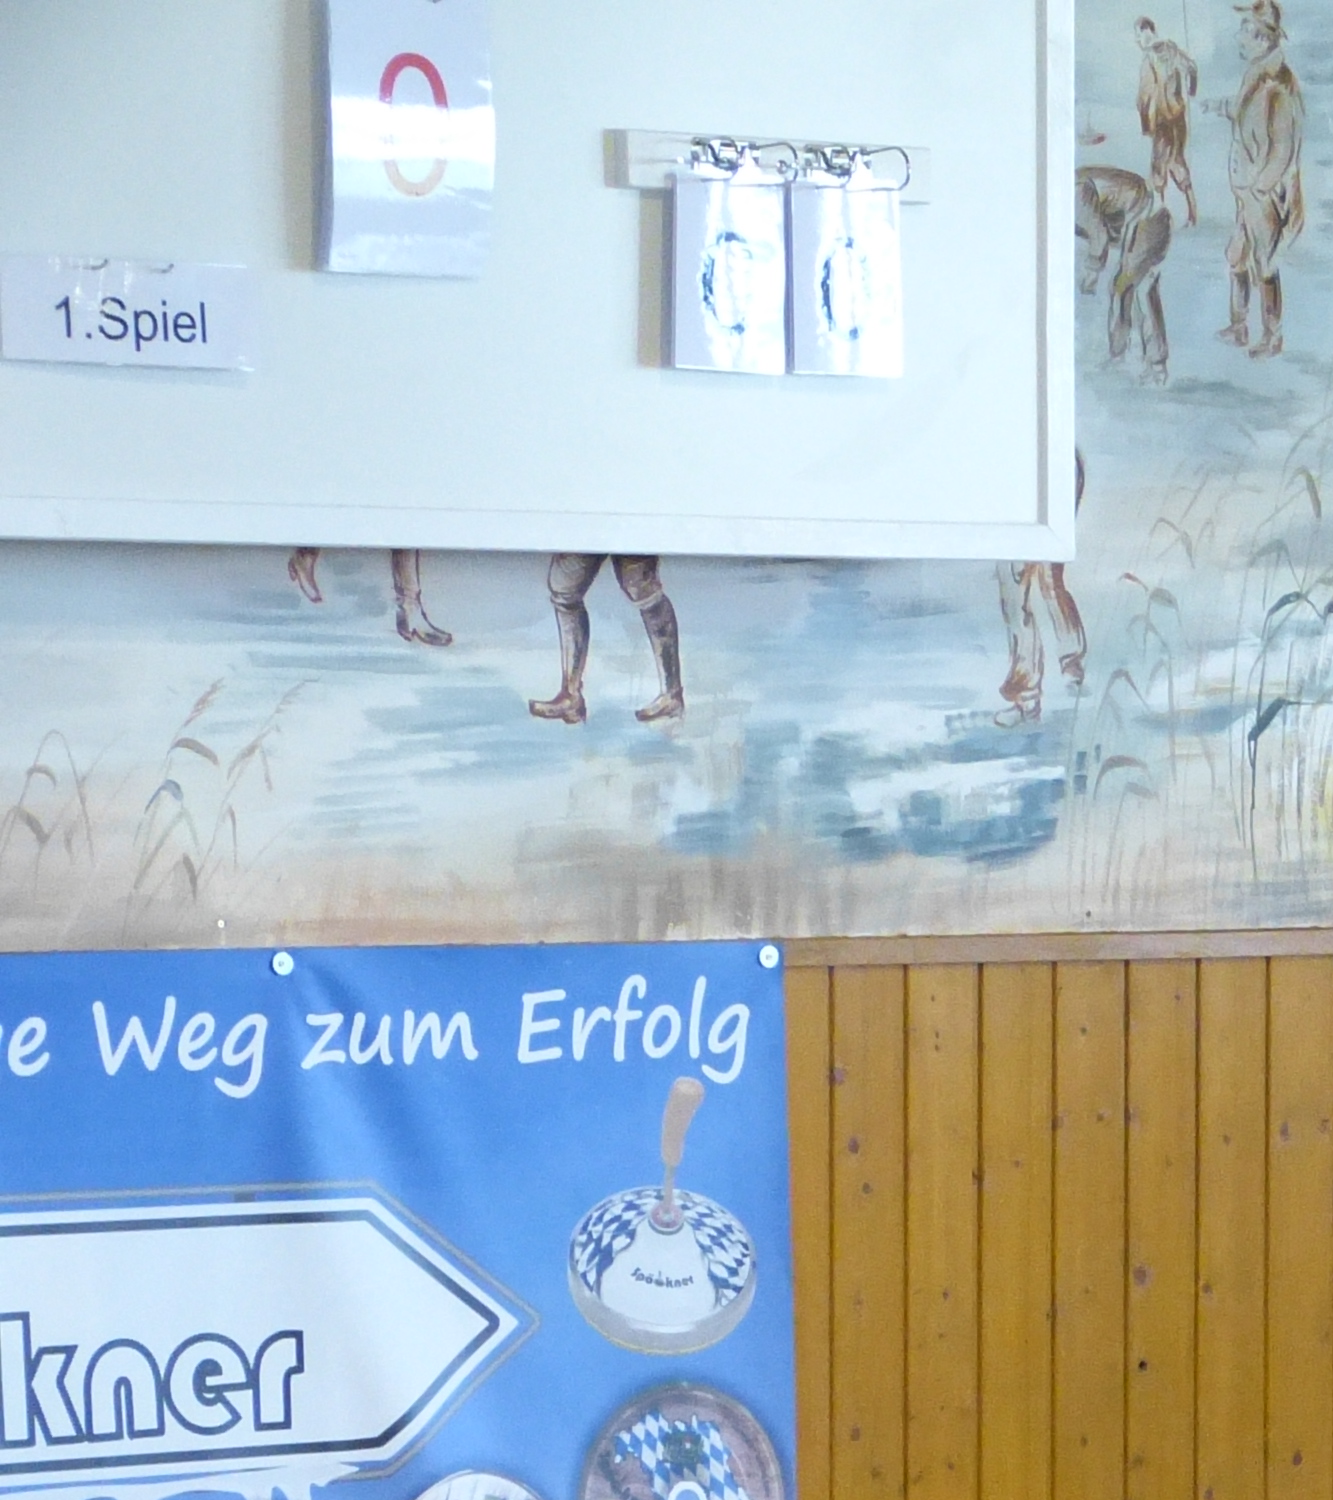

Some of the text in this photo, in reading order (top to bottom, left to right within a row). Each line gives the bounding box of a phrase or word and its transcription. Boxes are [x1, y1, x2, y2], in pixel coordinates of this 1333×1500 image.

[0, 973, 750, 1099] e Weg zum Erfolg
